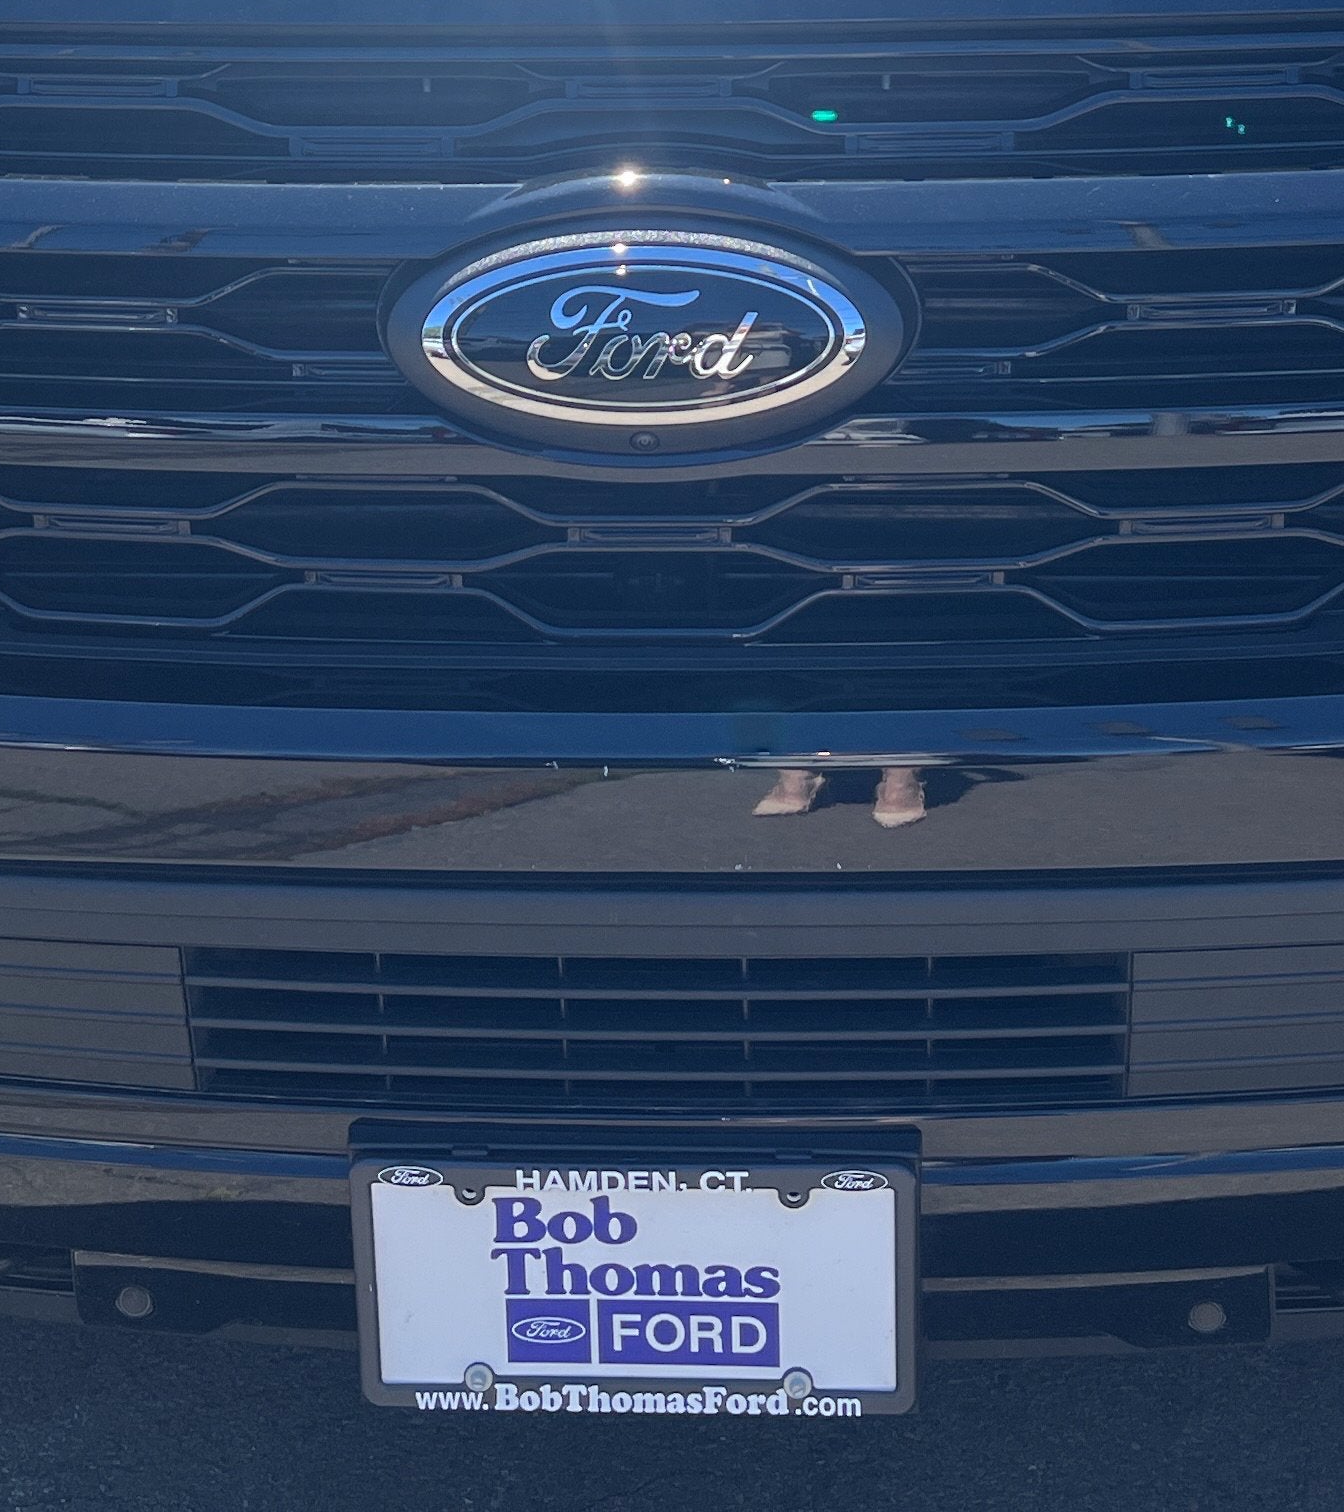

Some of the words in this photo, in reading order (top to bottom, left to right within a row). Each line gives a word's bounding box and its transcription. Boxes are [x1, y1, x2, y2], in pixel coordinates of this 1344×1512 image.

[525, 285, 760, 382] Ford
[389, 1168, 431, 1186] Ford
[699, 1170, 753, 1193] CT.
[834, 1173, 875, 1190] Ford
[491, 1195, 639, 1246] Bob
[490, 1246, 782, 1299] Thomas
[525, 1318, 573, 1342] Ford
[611, 1313, 769, 1355] FORD
